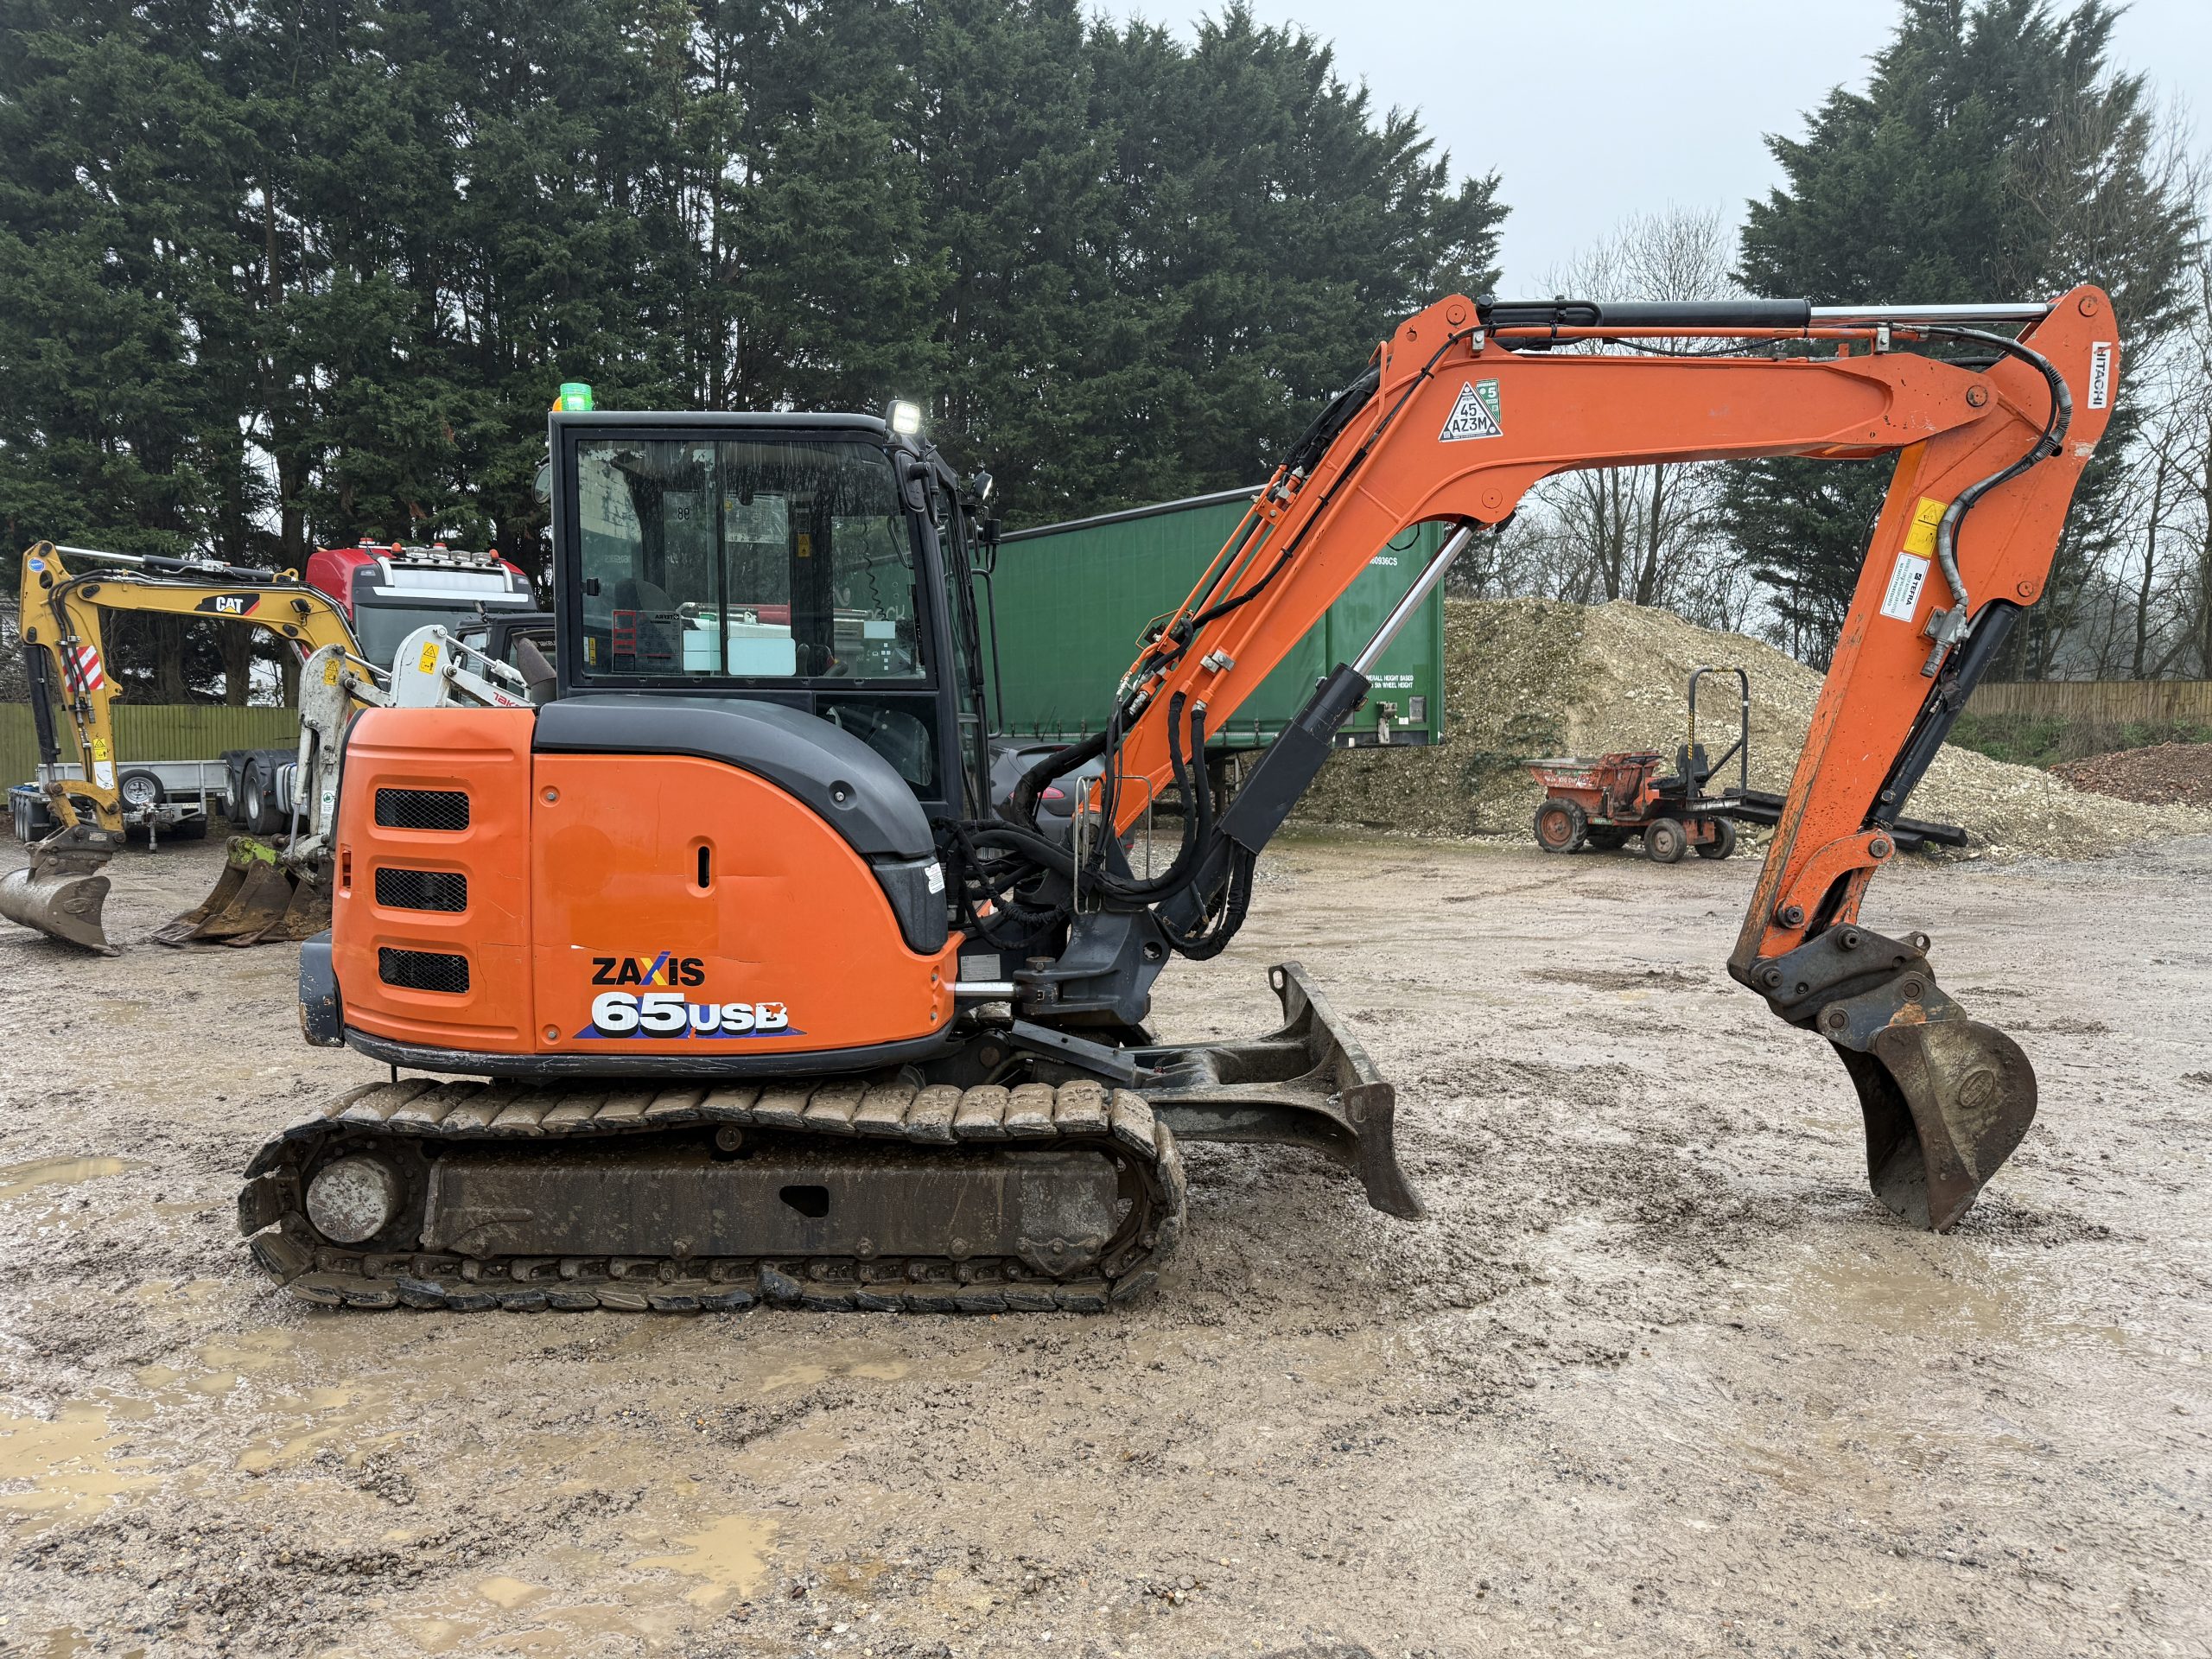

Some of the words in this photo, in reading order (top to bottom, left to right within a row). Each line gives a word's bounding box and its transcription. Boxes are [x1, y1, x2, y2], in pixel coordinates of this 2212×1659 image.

[2093, 346, 2107, 405] HITACHI
[1488, 387, 1496, 397] 5
[1461, 404, 1477, 416] 45
[1452, 416, 1487, 433] AZ3M
[1906, 581, 1917, 605] TEFRA
[216, 596, 243, 613] CAT
[592, 951, 705, 987] ZAXIS
